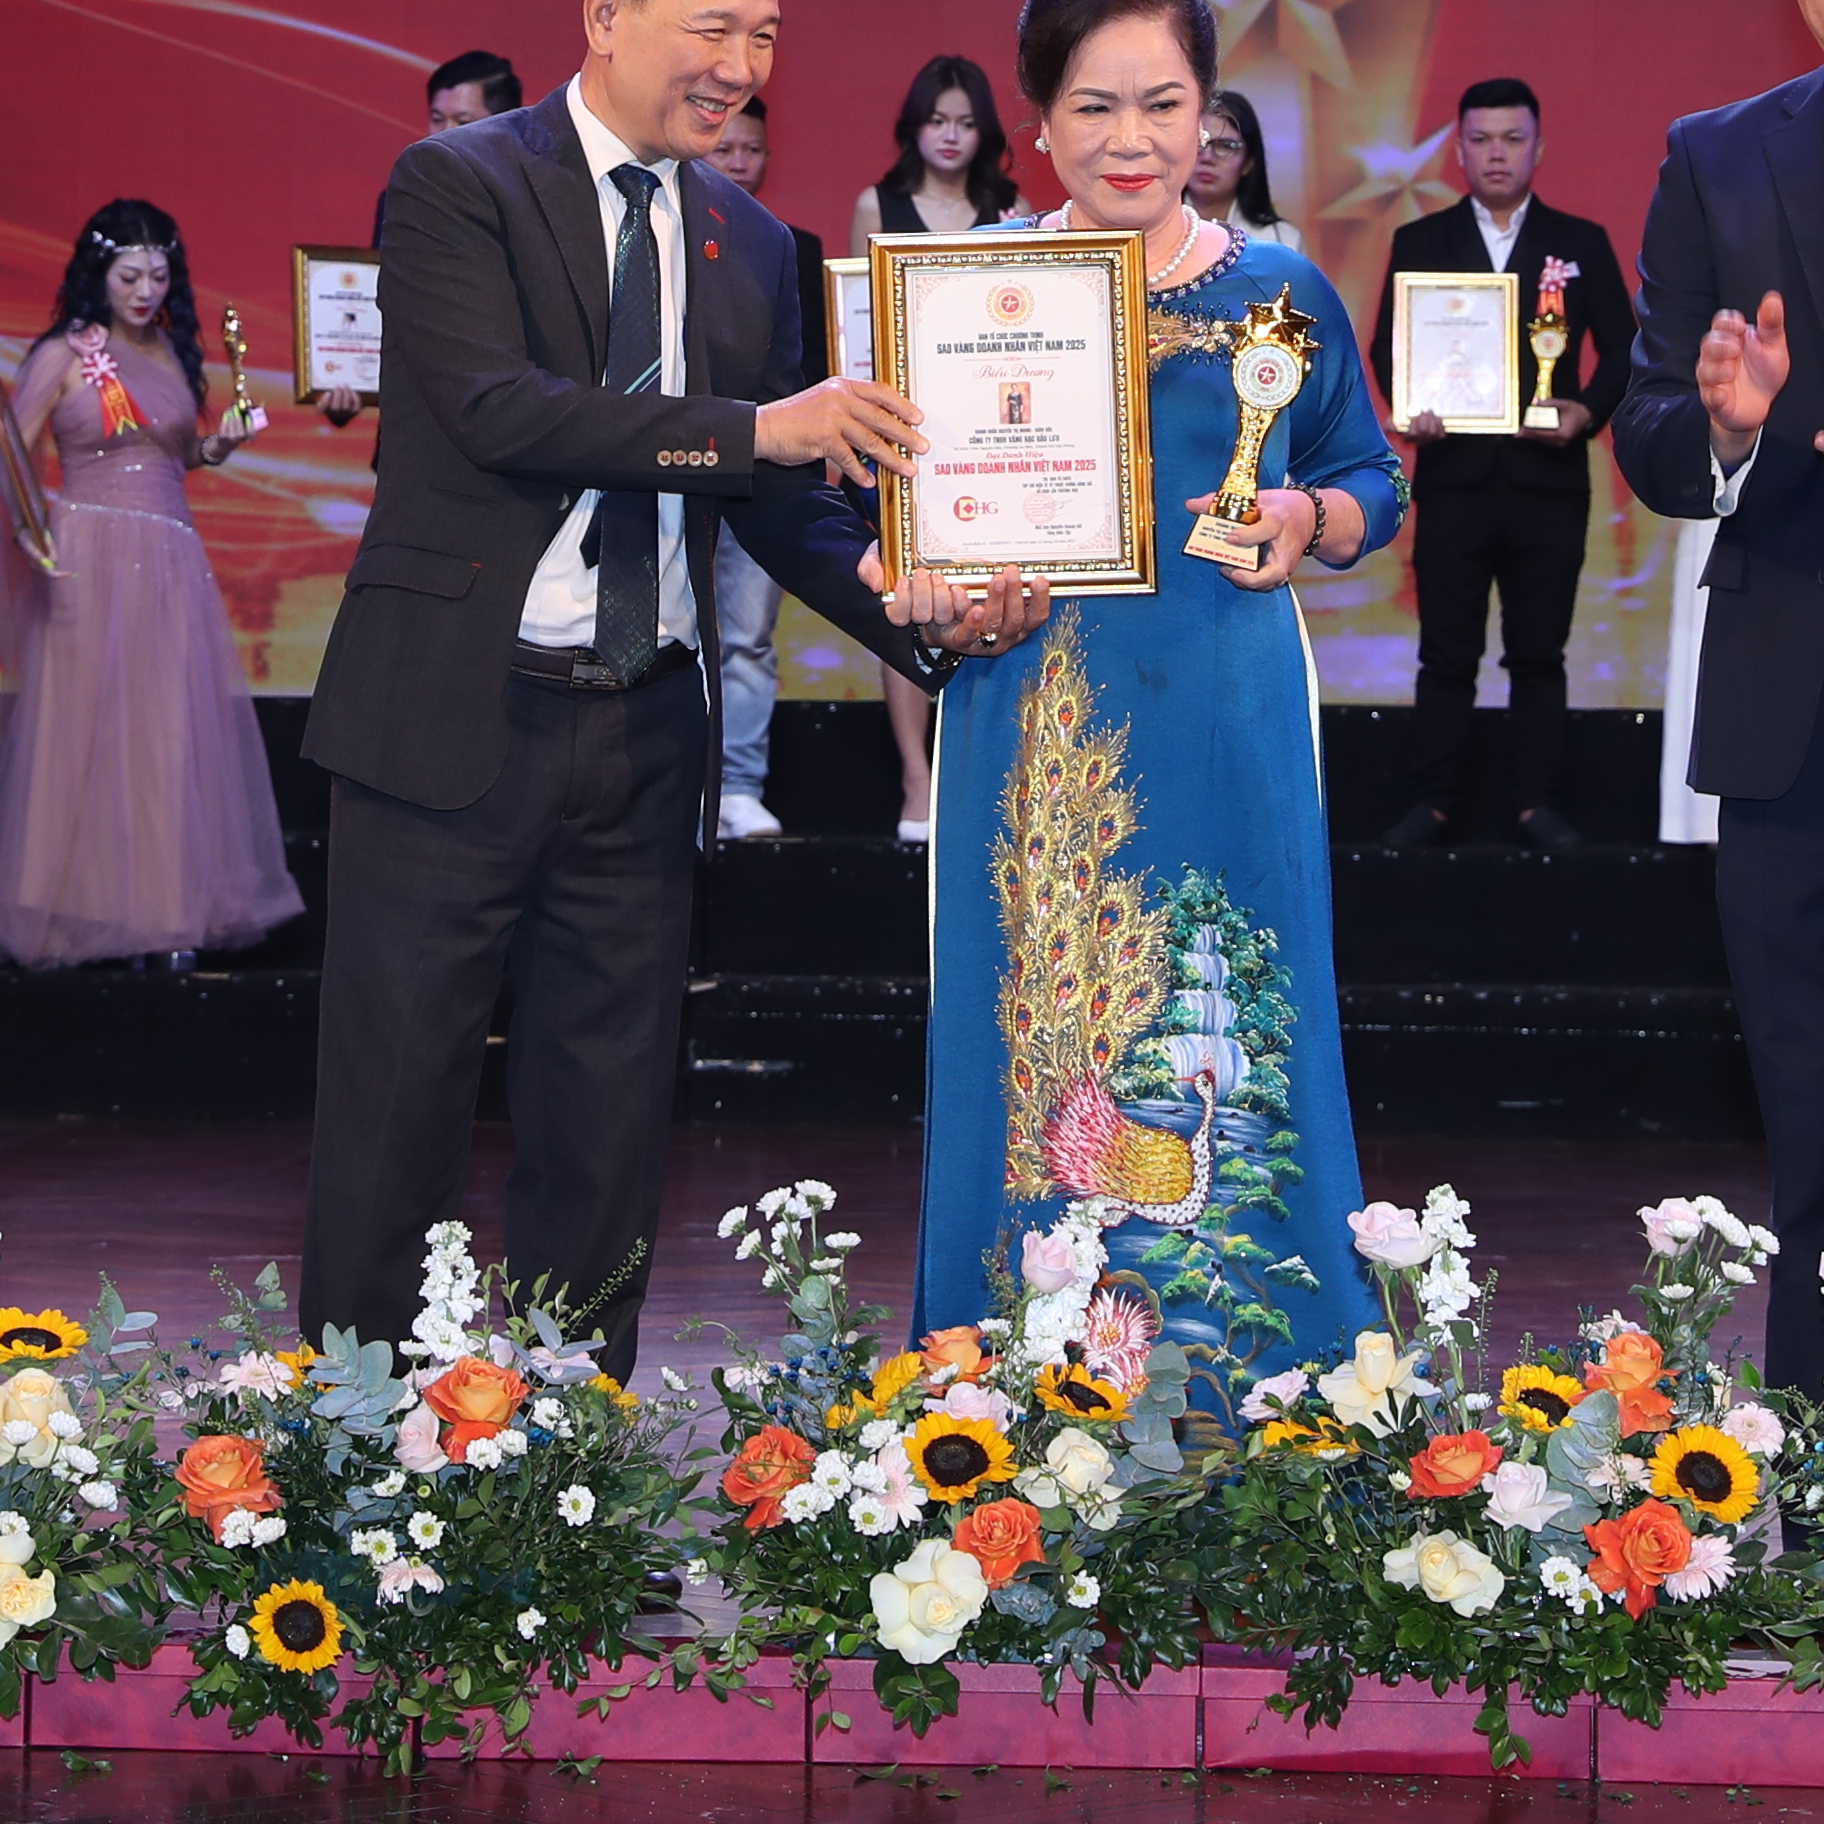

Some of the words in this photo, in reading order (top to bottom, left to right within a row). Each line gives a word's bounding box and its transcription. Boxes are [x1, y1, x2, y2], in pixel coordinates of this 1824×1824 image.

[937, 343, 952, 354] SAO
[954, 341, 974, 354] VÀNG
[977, 341, 1002, 353] DOANH
[1004, 339, 1026, 352] NHÂN
[1028, 339, 1043, 354] VIỆT
[1045, 340, 1063, 351] NAM
[1065, 339, 1086, 350] 2025
[934, 464, 951, 475] SAO
[953, 461, 975, 475] VÀNG
[977, 462, 1005, 474] DOANH
[1008, 459, 1031, 473] NHÂN
[1033, 459, 1050, 475] VIỆT
[1052, 460, 1072, 472] NAM
[1075, 459, 1097, 471] 2025
